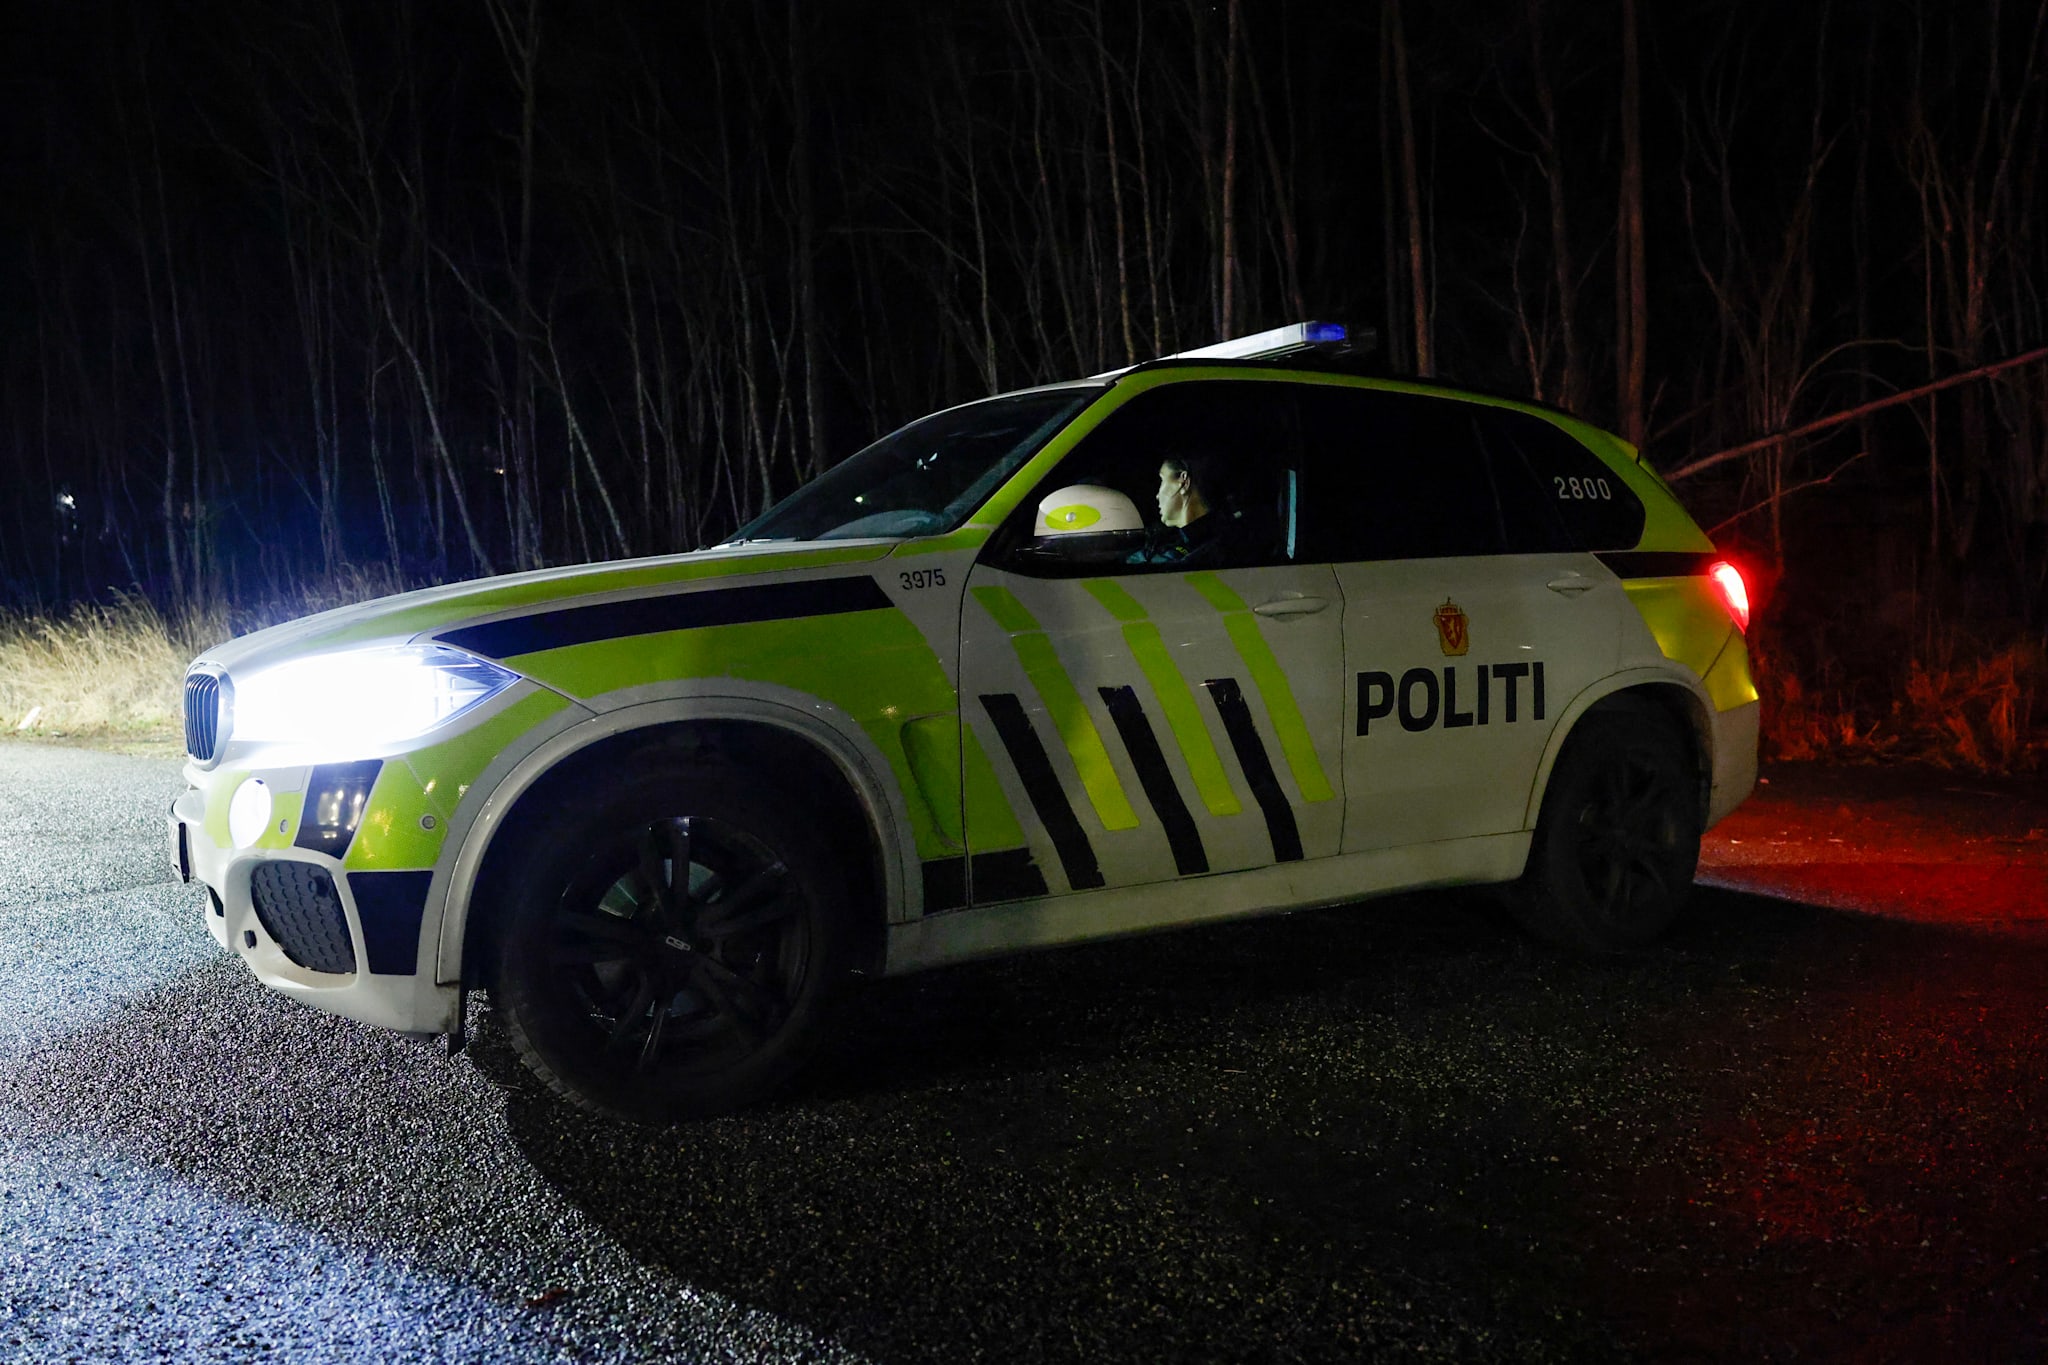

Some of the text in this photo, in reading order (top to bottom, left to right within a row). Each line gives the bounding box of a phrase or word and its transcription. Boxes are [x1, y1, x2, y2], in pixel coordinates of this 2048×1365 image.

[1553, 476, 1612, 501] 2800
[900, 568, 946, 590] 3975
[1356, 662, 1545, 737] POLITI
